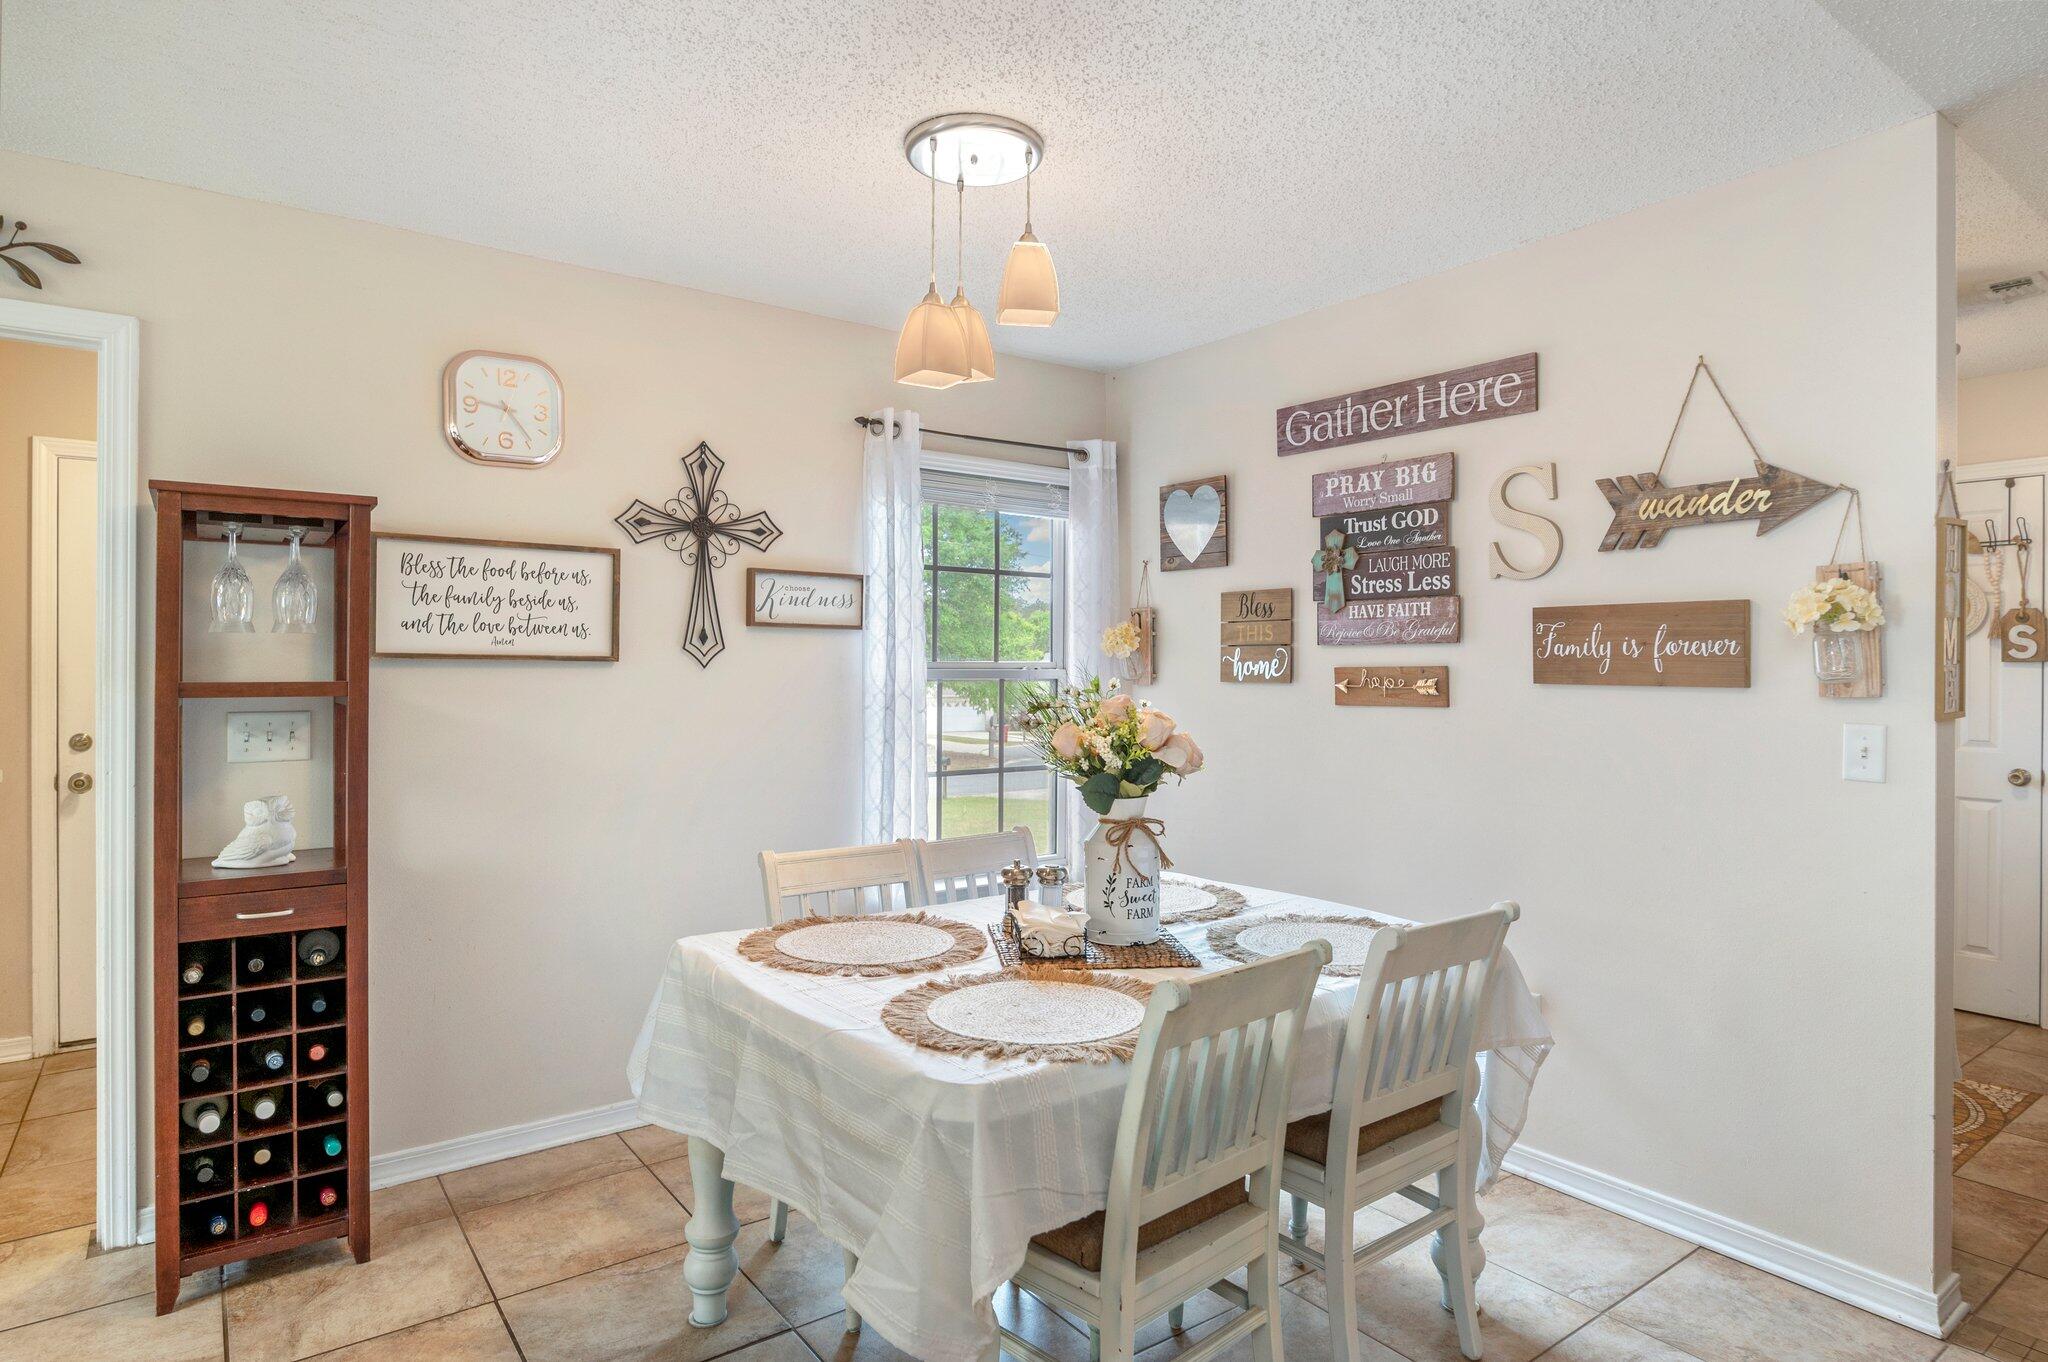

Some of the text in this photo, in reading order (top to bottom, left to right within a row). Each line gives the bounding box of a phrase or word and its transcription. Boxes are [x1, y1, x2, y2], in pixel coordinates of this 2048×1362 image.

[498, 368, 518, 388] 12
[463, 395, 478, 413] 9
[534, 404, 549, 422] 3
[1285, 372, 1522, 446] Gather Here
[499, 431, 514, 449] 6
[1325, 462, 1437, 497] PRAY BIG
[1343, 488, 1413, 509] Worry Small
[1639, 478, 1772, 521] wander
[1344, 508, 1439, 534] Trust GOD
[1489, 462, 1563, 581] S
[1356, 530, 1442, 548] Love One Another
[400, 552, 592, 586] Bless the food before us,
[1369, 552, 1451, 573] LAUGH MORE
[1351, 571, 1451, 595] Stress Less
[401, 580, 579, 614] the family beside us,
[756, 577, 857, 619] Kindness
[1236, 592, 1276, 619] Bless
[1349, 601, 1431, 619] HAVE FAITH
[1944, 525, 1961, 713] HME
[401, 612, 592, 640] and the love between us.
[1237, 624, 1273, 641] THIS
[1319, 620, 1364, 643] Rejoice
[1377, 621, 1398, 638] Be
[1402, 619, 1456, 640] Grateful
[491, 636, 515, 647] Amen
[1535, 621, 1741, 675] Family is forever
[2007, 624, 2038, 659] S
[1222, 647, 1288, 681] home
[1360, 668, 1405, 698] hope
[1126, 876, 1154, 889] FARM
[1118, 889, 1157, 908] Sweet
[1127, 907, 1154, 920] FARM
